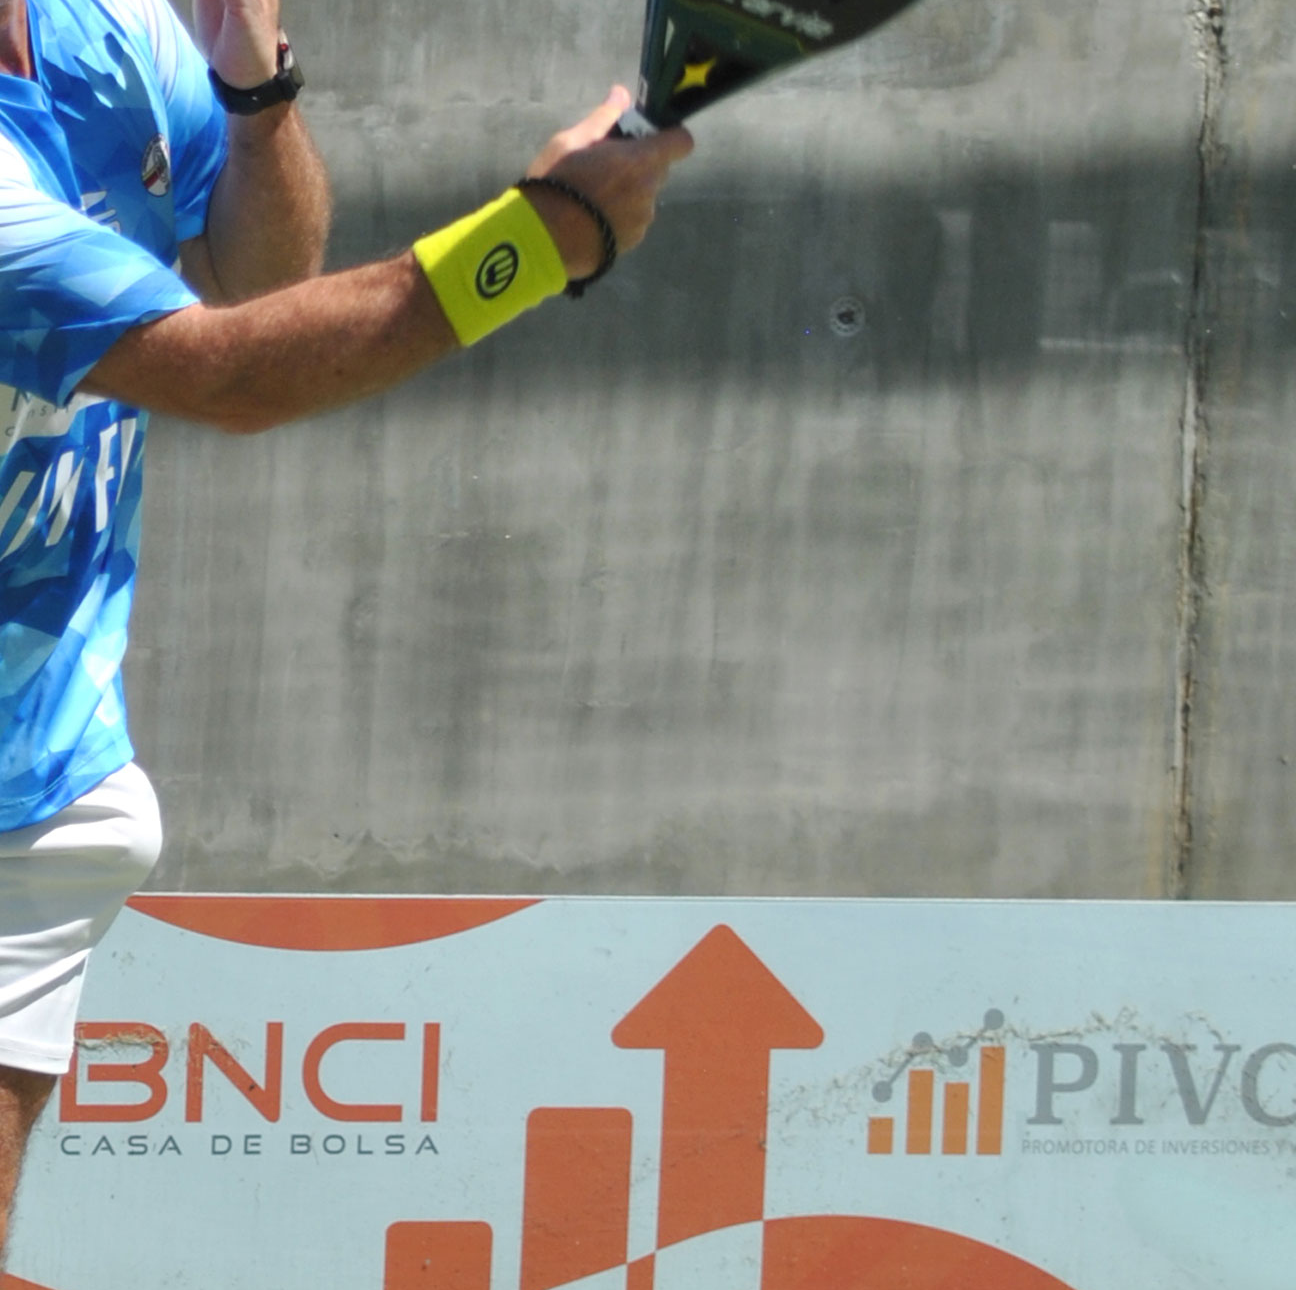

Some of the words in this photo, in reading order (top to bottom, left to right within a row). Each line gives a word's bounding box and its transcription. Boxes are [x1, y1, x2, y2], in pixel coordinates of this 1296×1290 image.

[59, 1021, 442, 1123] BNCI
[59, 1134, 183, 1156] CASA
[210, 1134, 263, 1155] DE
[290, 1134, 440, 1155] BOLSA
[1020, 1138, 1130, 1156] PROMOTORA
[1134, 1139, 1157, 1156] DE
[1161, 1139, 1271, 1156] INVERSIONES
